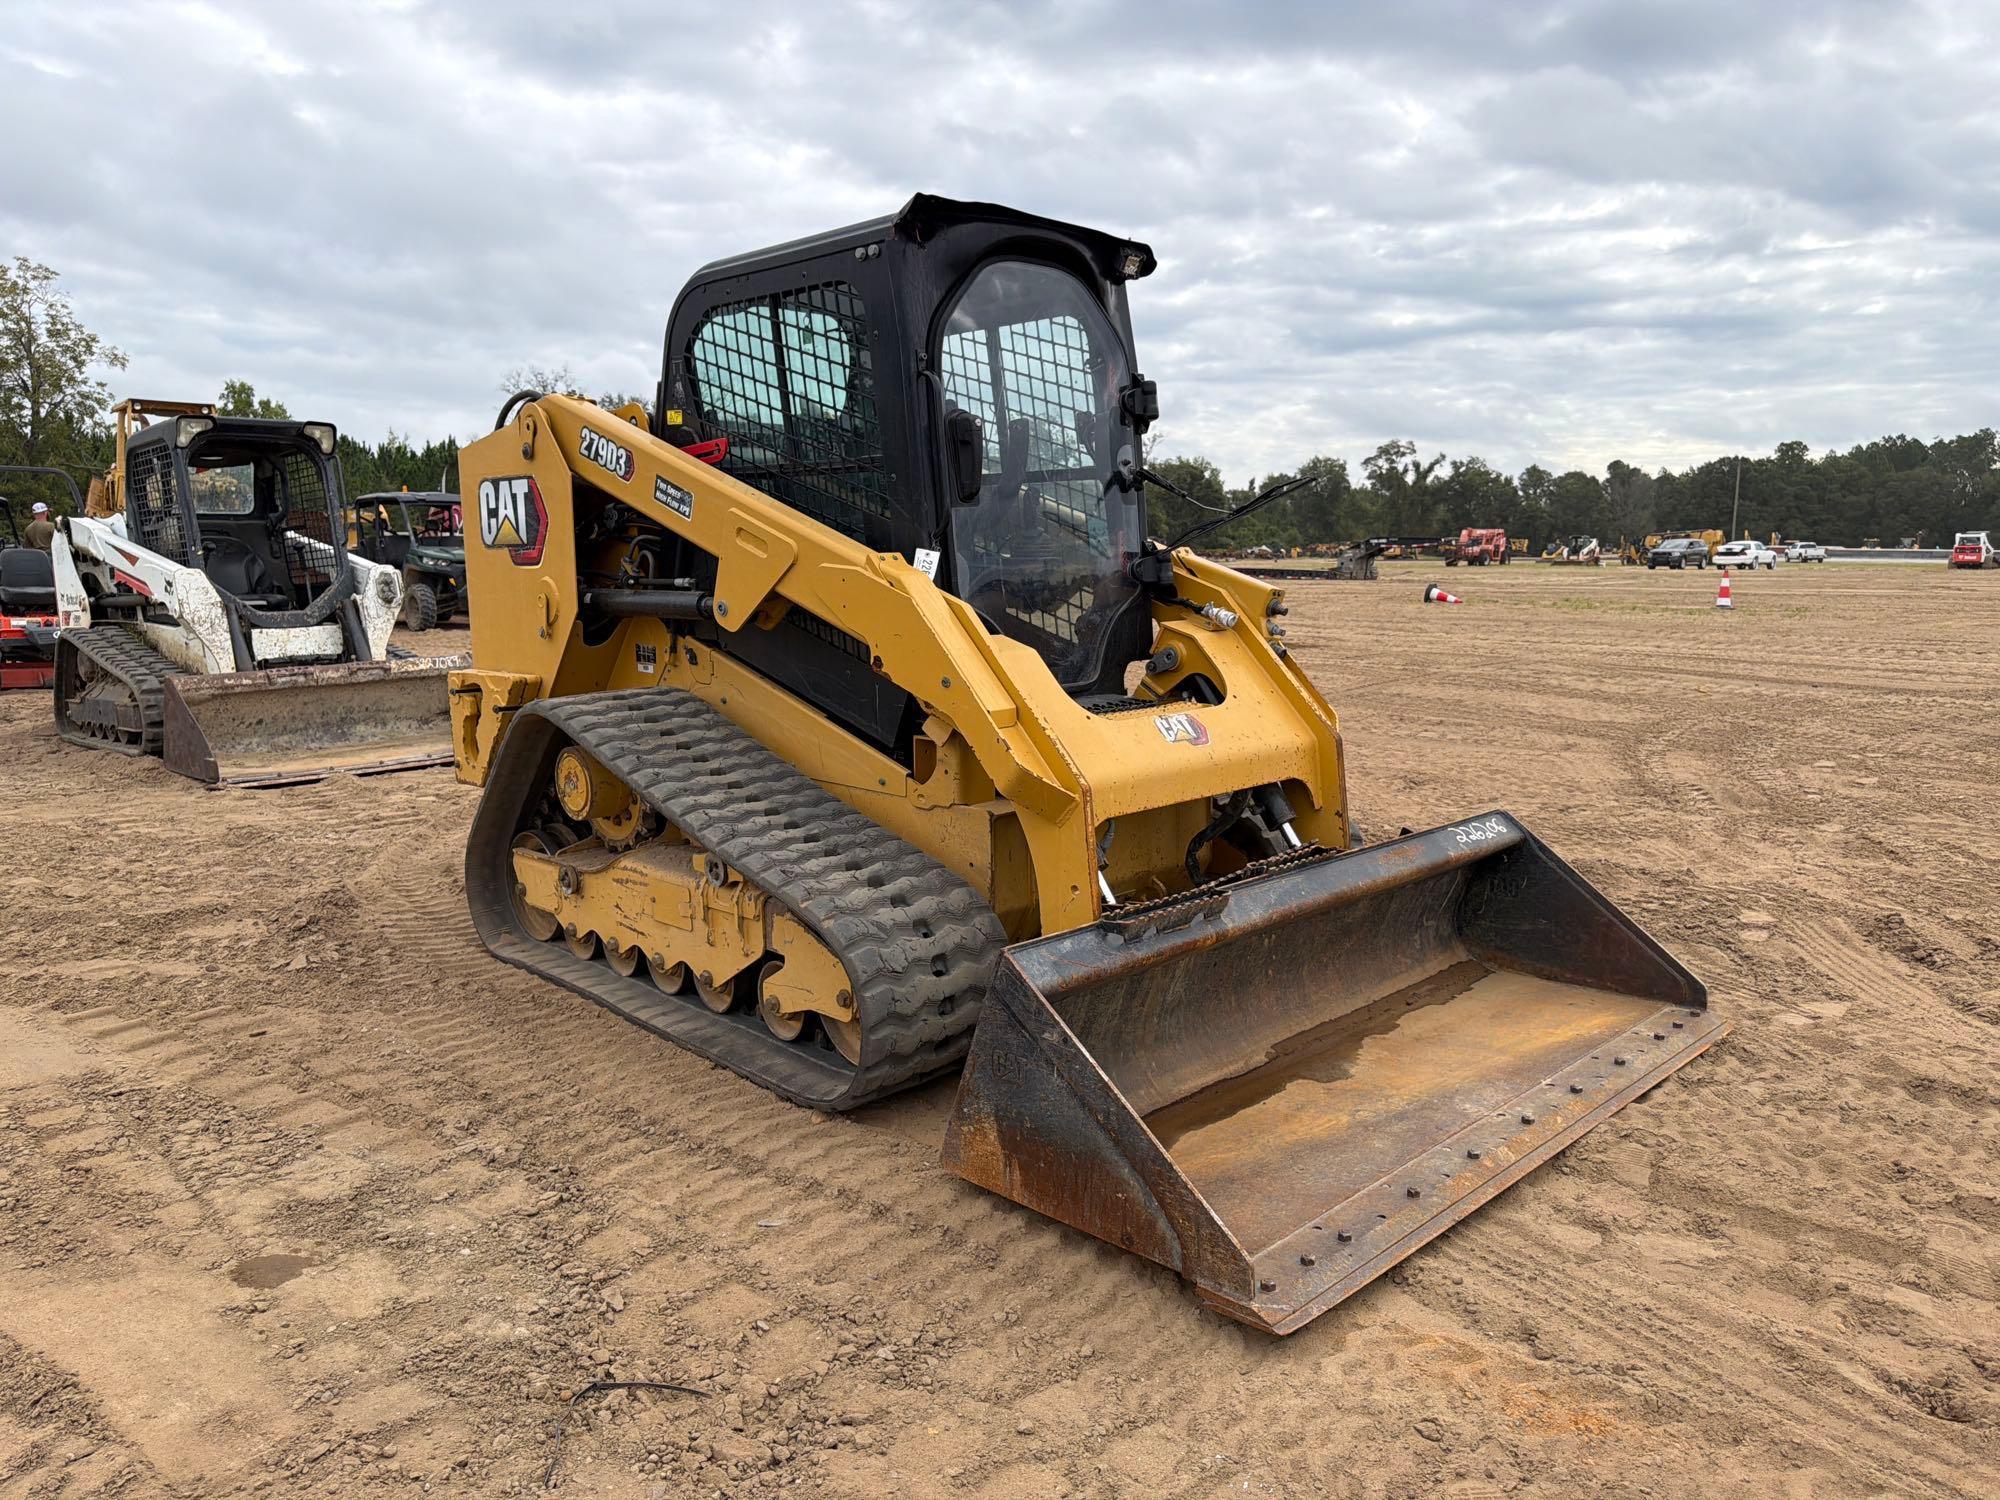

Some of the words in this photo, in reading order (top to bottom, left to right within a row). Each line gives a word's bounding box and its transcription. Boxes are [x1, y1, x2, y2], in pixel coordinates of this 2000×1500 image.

[580, 427, 626, 477] 279D3
[479, 479, 529, 546] CAT
[1154, 714, 1197, 742] CAT
